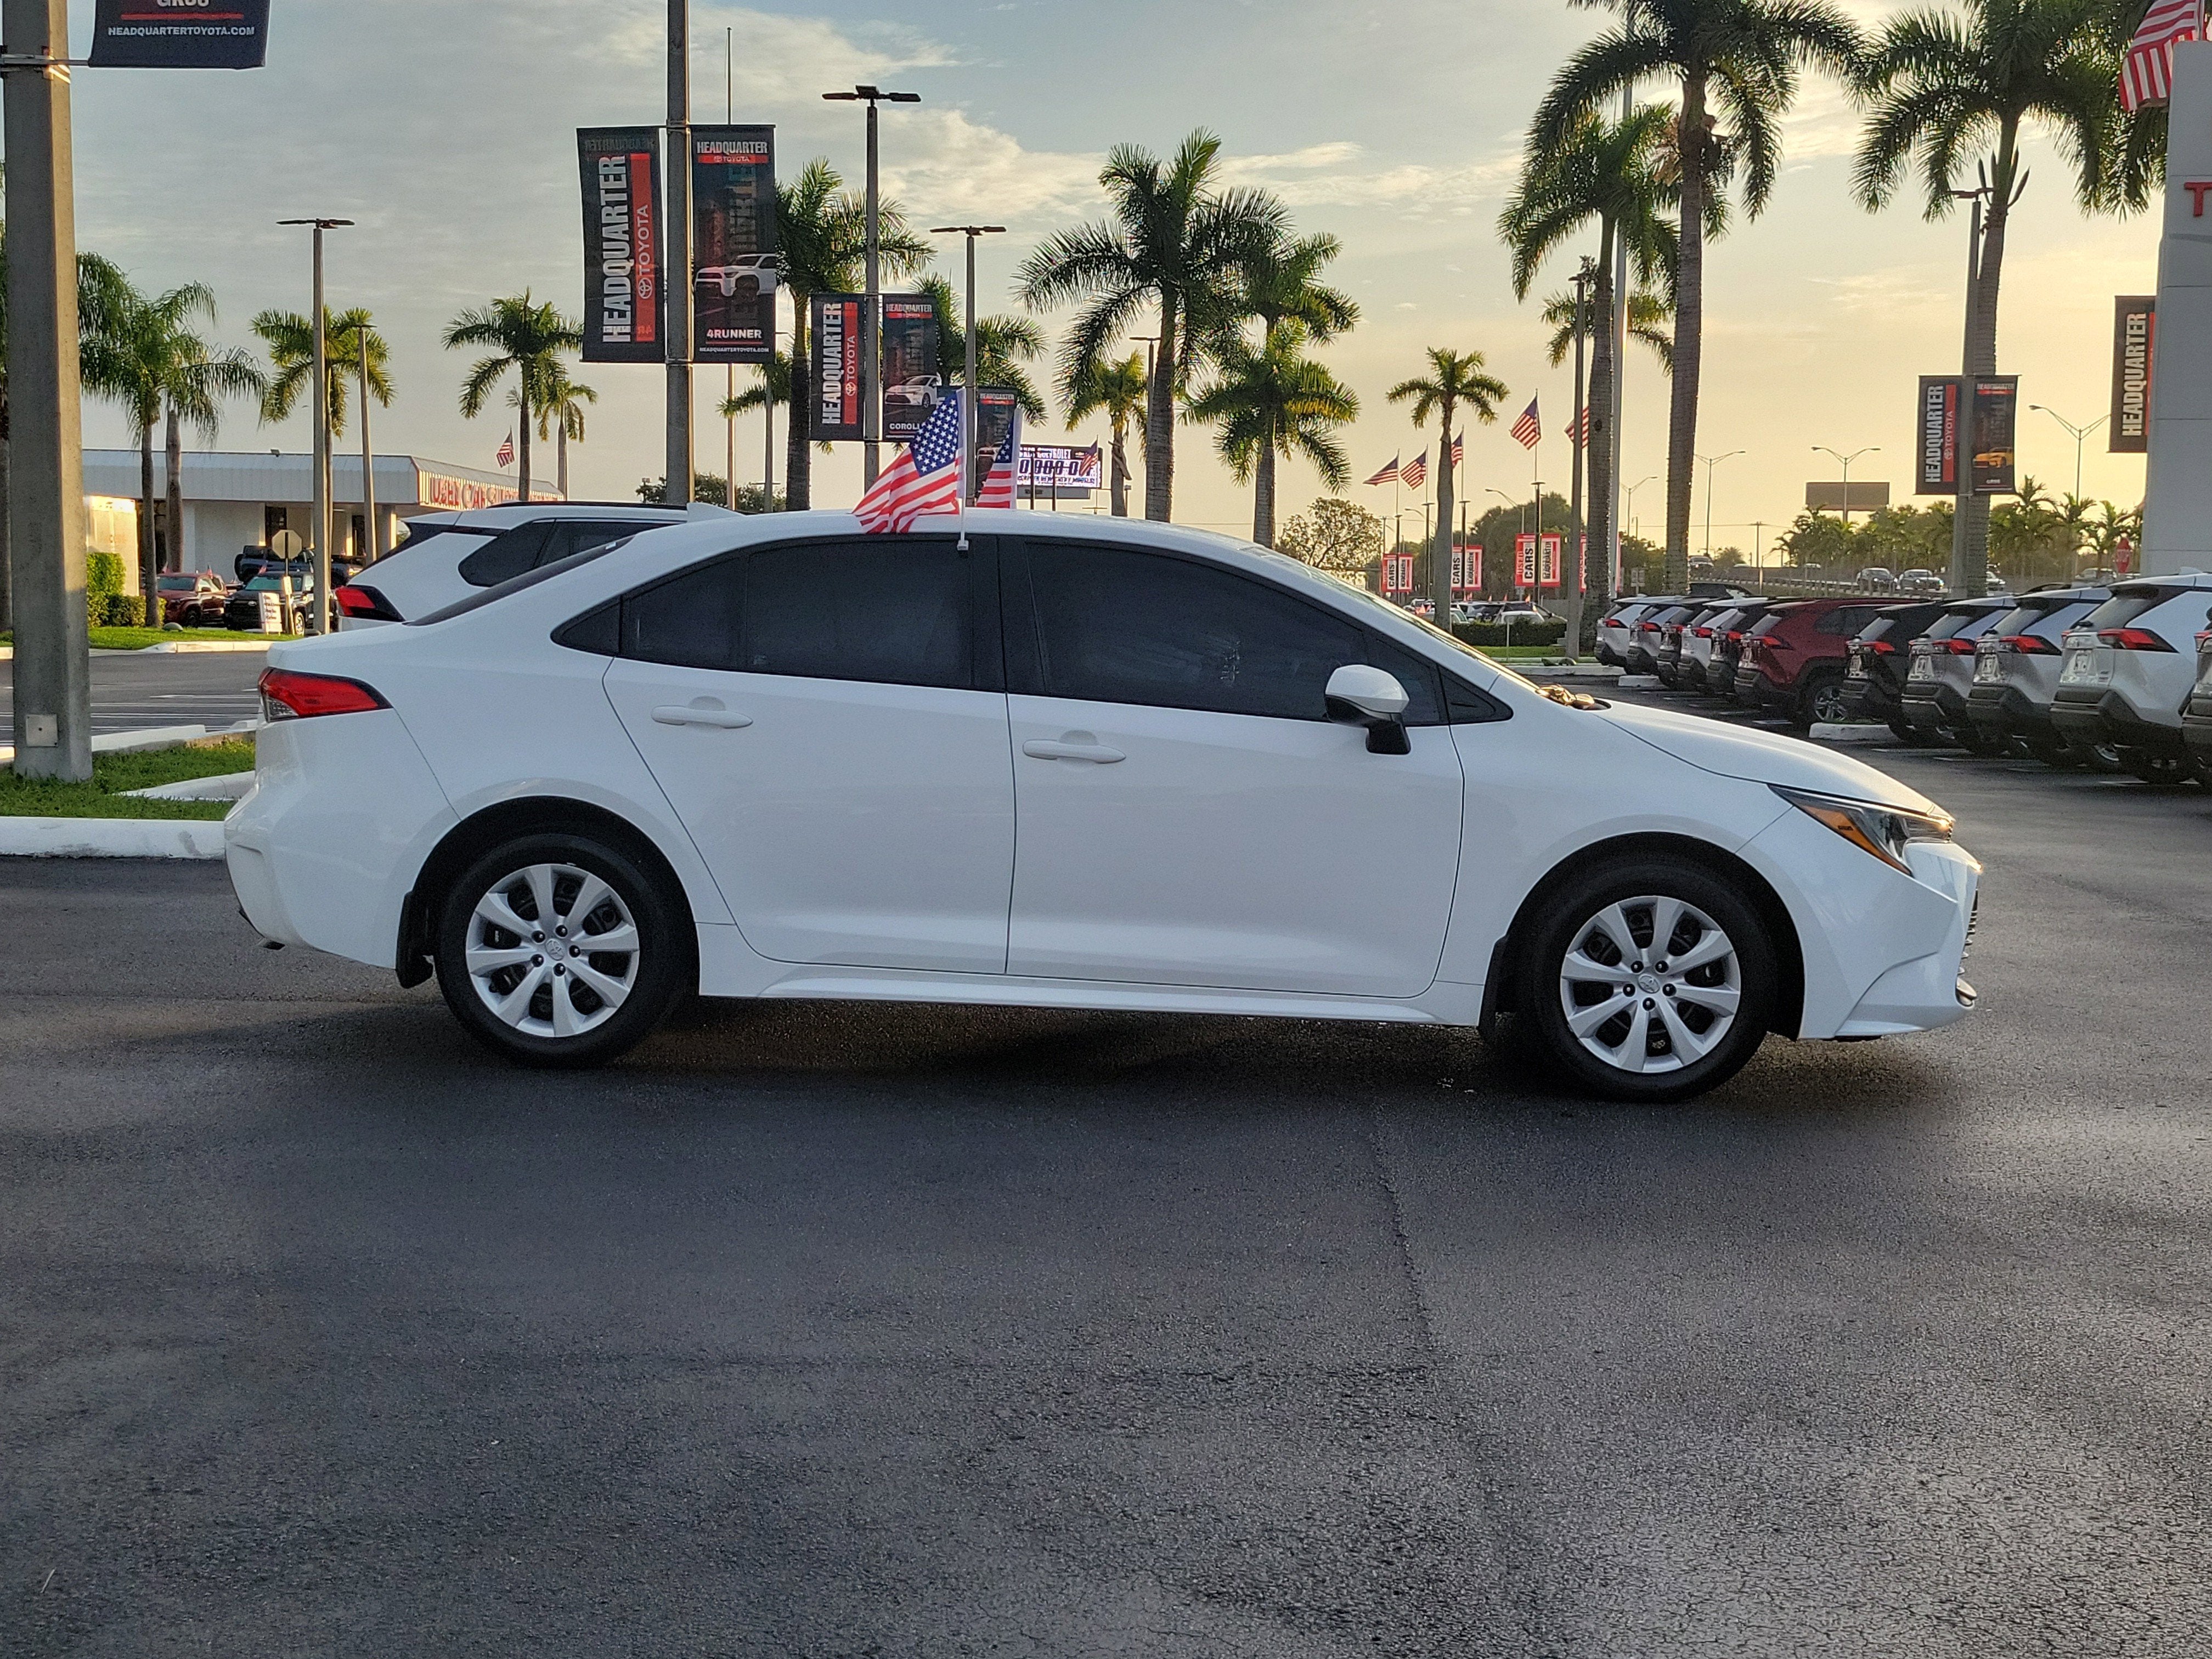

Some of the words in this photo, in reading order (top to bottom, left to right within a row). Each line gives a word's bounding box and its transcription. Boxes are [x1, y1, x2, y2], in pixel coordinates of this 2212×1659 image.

[108, 27, 255, 36] HEADQUARTERTOYOTA.COM
[697, 141, 768, 155] HEADQUARTER
[599, 155, 635, 342] HEADQUARTER
[636, 204, 651, 275] TOYOTA
[706, 329, 762, 338] 4RUNNER
[822, 303, 844, 424] HEADQUARTER
[847, 335, 856, 381] TOYOTA
[2122, 312, 2147, 436] HEADQUARTER
[1925, 385, 1944, 483] HEADQUARTER
[1944, 411, 1953, 448] TOYOTA
[1452, 557, 1460, 584] CARS
[1525, 548, 1533, 579] CARS
